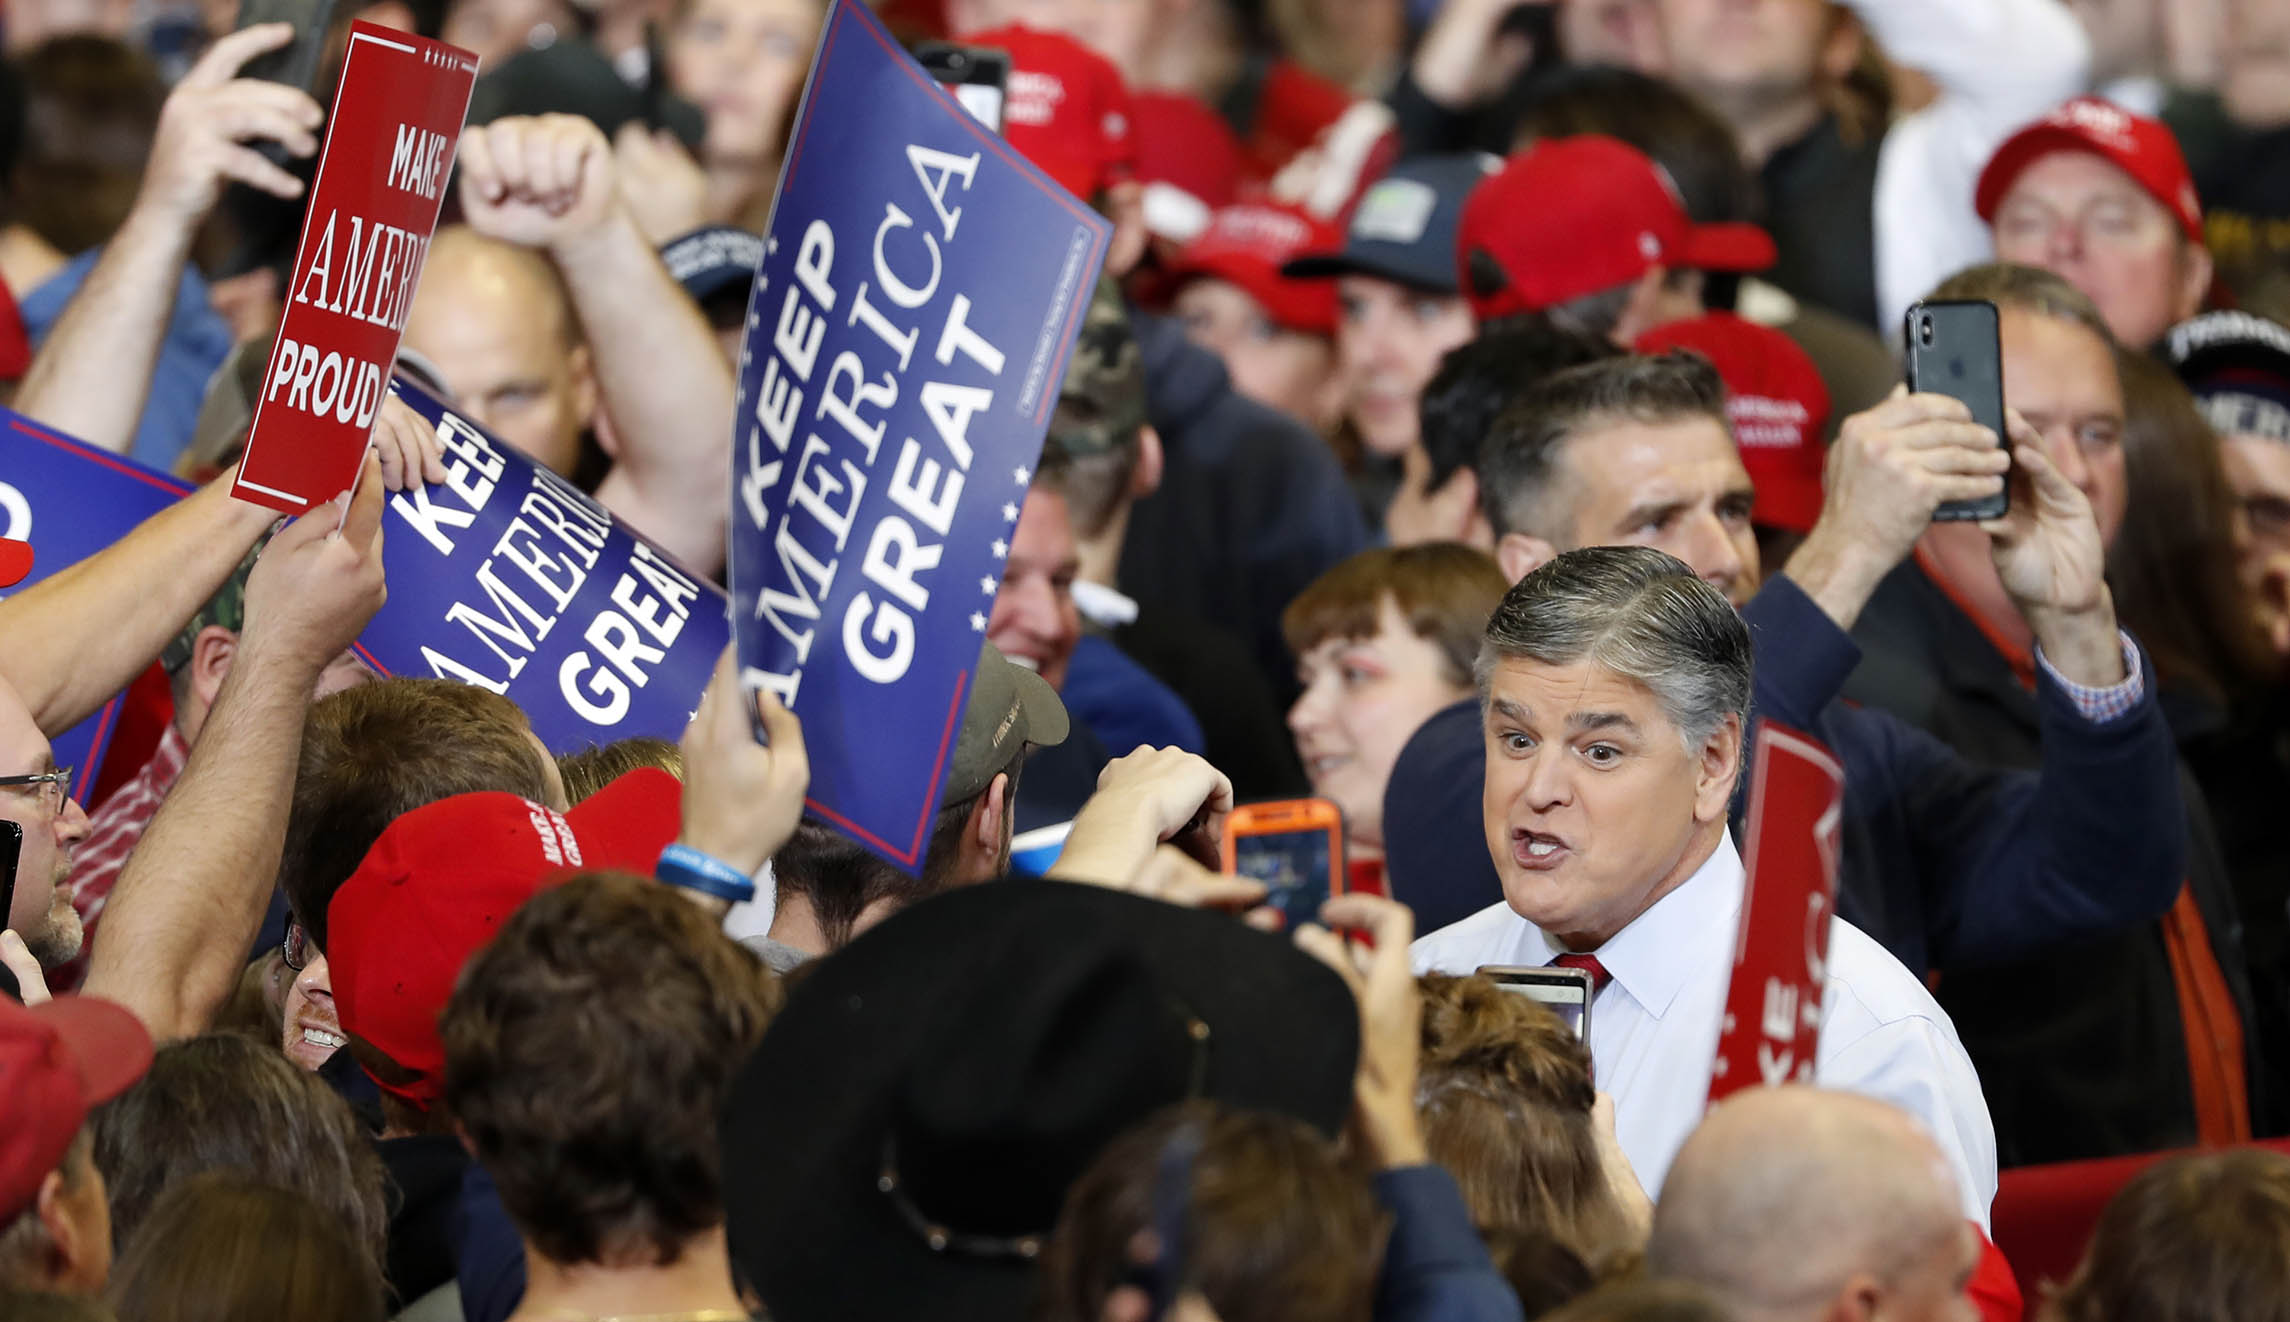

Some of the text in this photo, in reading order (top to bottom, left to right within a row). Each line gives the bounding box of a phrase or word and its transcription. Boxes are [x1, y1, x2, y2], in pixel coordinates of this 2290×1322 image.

[387, 123, 447, 199] MAKE
[268, 338, 381, 430] PROUD
[741, 219, 837, 530] KEEP
[390, 411, 506, 556] KEEP
[842, 293, 1006, 684] GREAT
[559, 541, 700, 726] GREAT
